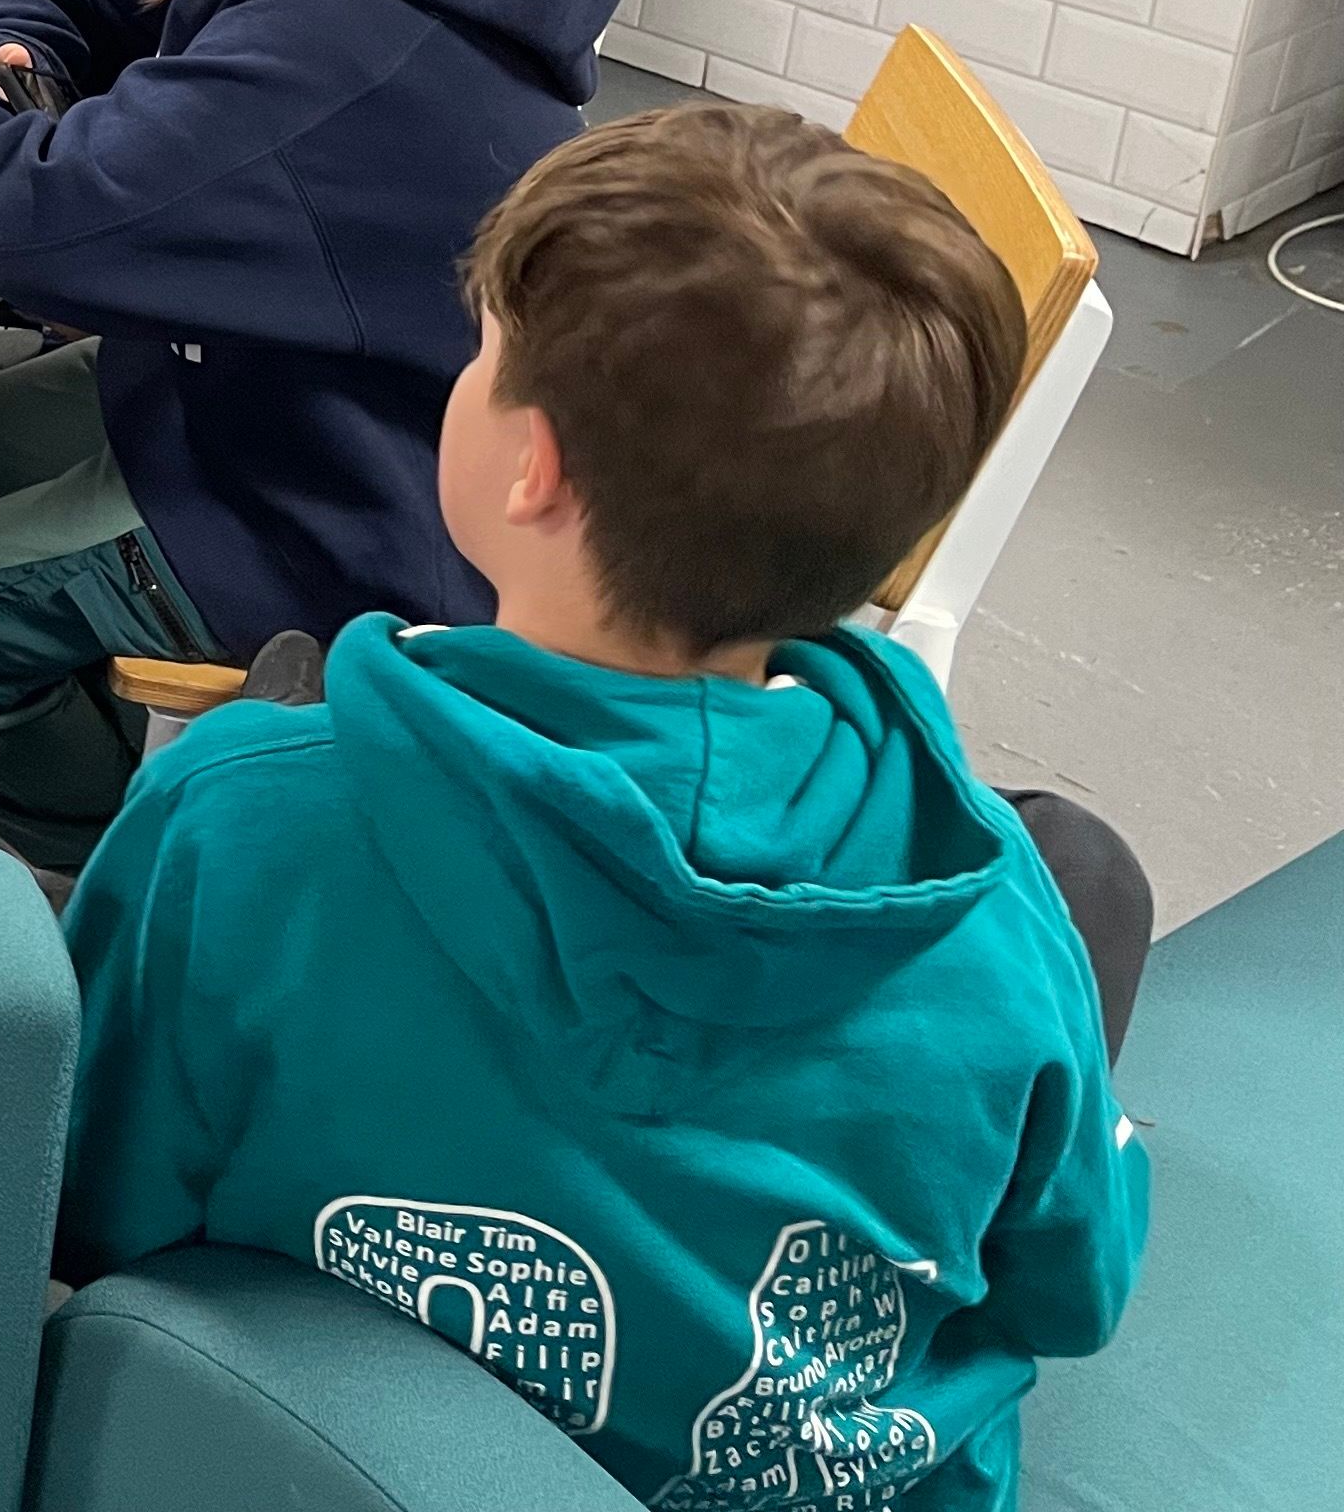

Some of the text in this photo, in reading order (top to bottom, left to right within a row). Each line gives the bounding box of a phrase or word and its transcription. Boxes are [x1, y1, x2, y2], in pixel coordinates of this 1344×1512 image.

[345, 1210, 588, 1287] Valene Sophie
[396, 1209, 537, 1253] Blair Tim
[328, 1227, 420, 1283] Sylvie
[487, 1282, 600, 1314] Alfie
[488, 1308, 598, 1339] Adam
[485, 1342, 601, 1372] Filip
[755, 1355, 827, 1397] Bruno
